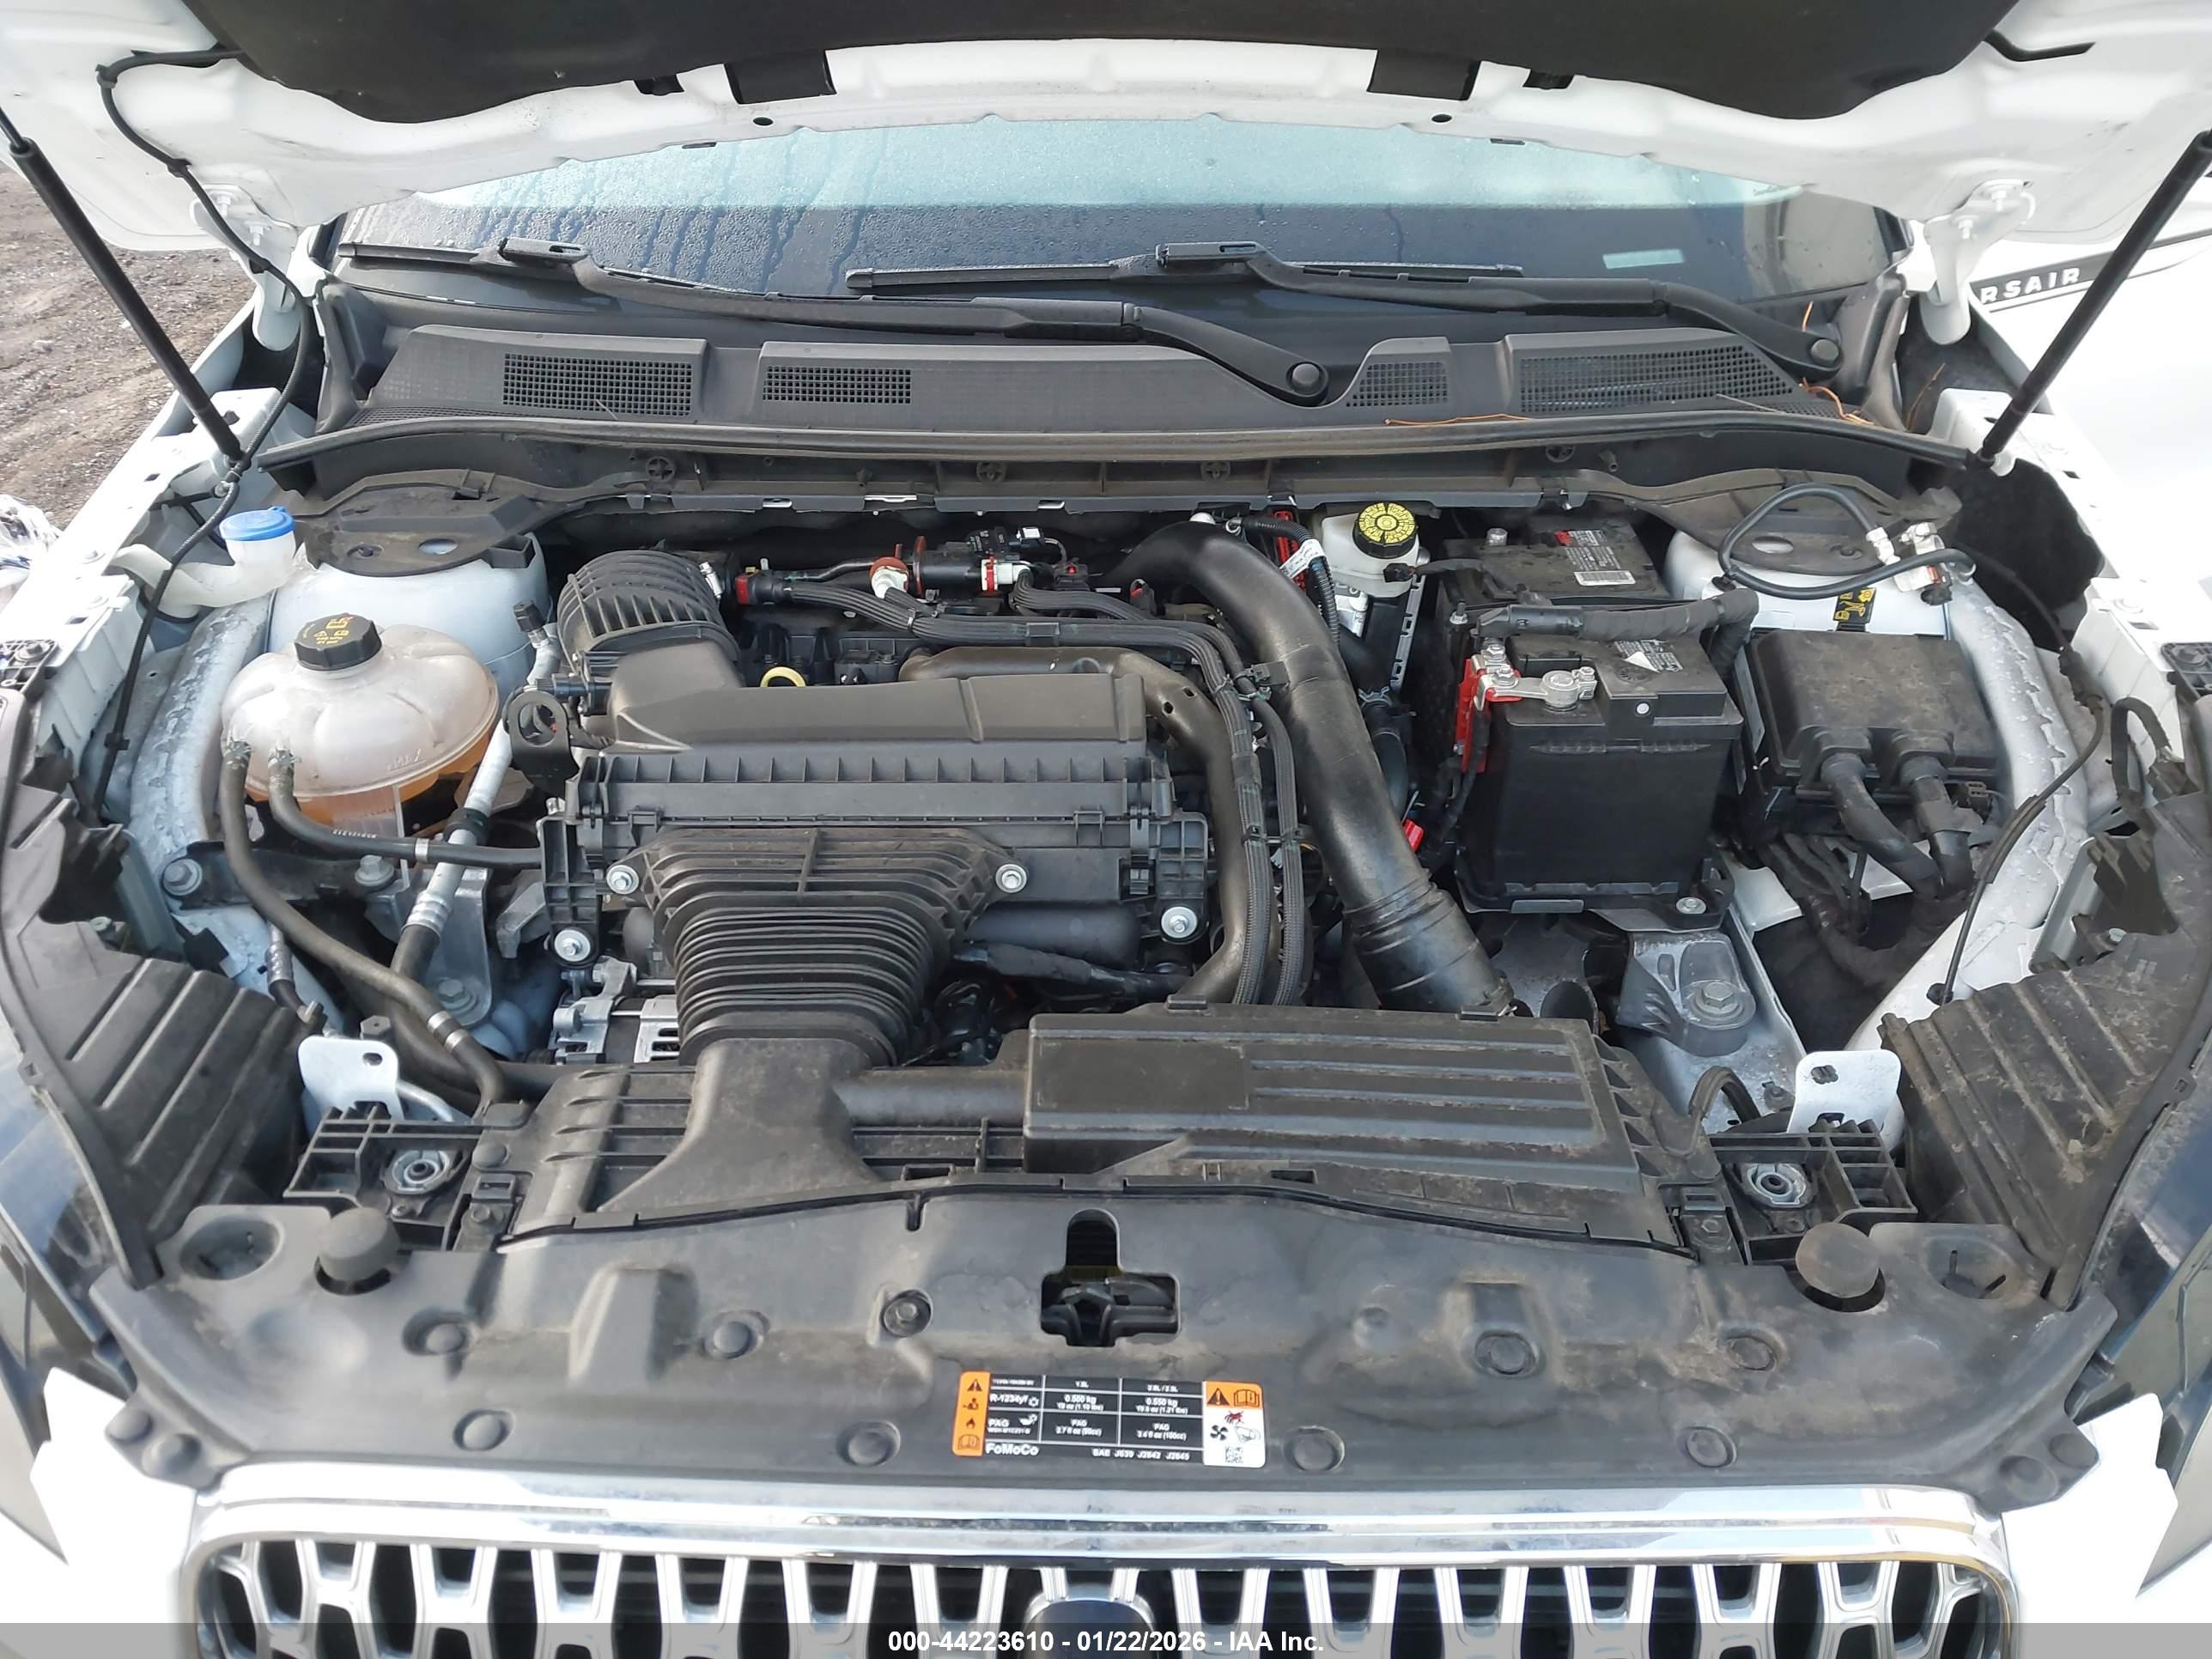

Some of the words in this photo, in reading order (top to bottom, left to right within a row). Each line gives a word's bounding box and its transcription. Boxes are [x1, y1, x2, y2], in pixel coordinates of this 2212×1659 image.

[989, 1393, 1029, 1405] R-1234yf
[1085, 1395, 1097, 1405] kg
[1167, 1399, 1178, 1408] kg
[988, 1418, 1010, 1427] PAG
[985, 1443, 1040, 1456] FoMoCo
[1092, 1449, 1111, 1457] SAE
